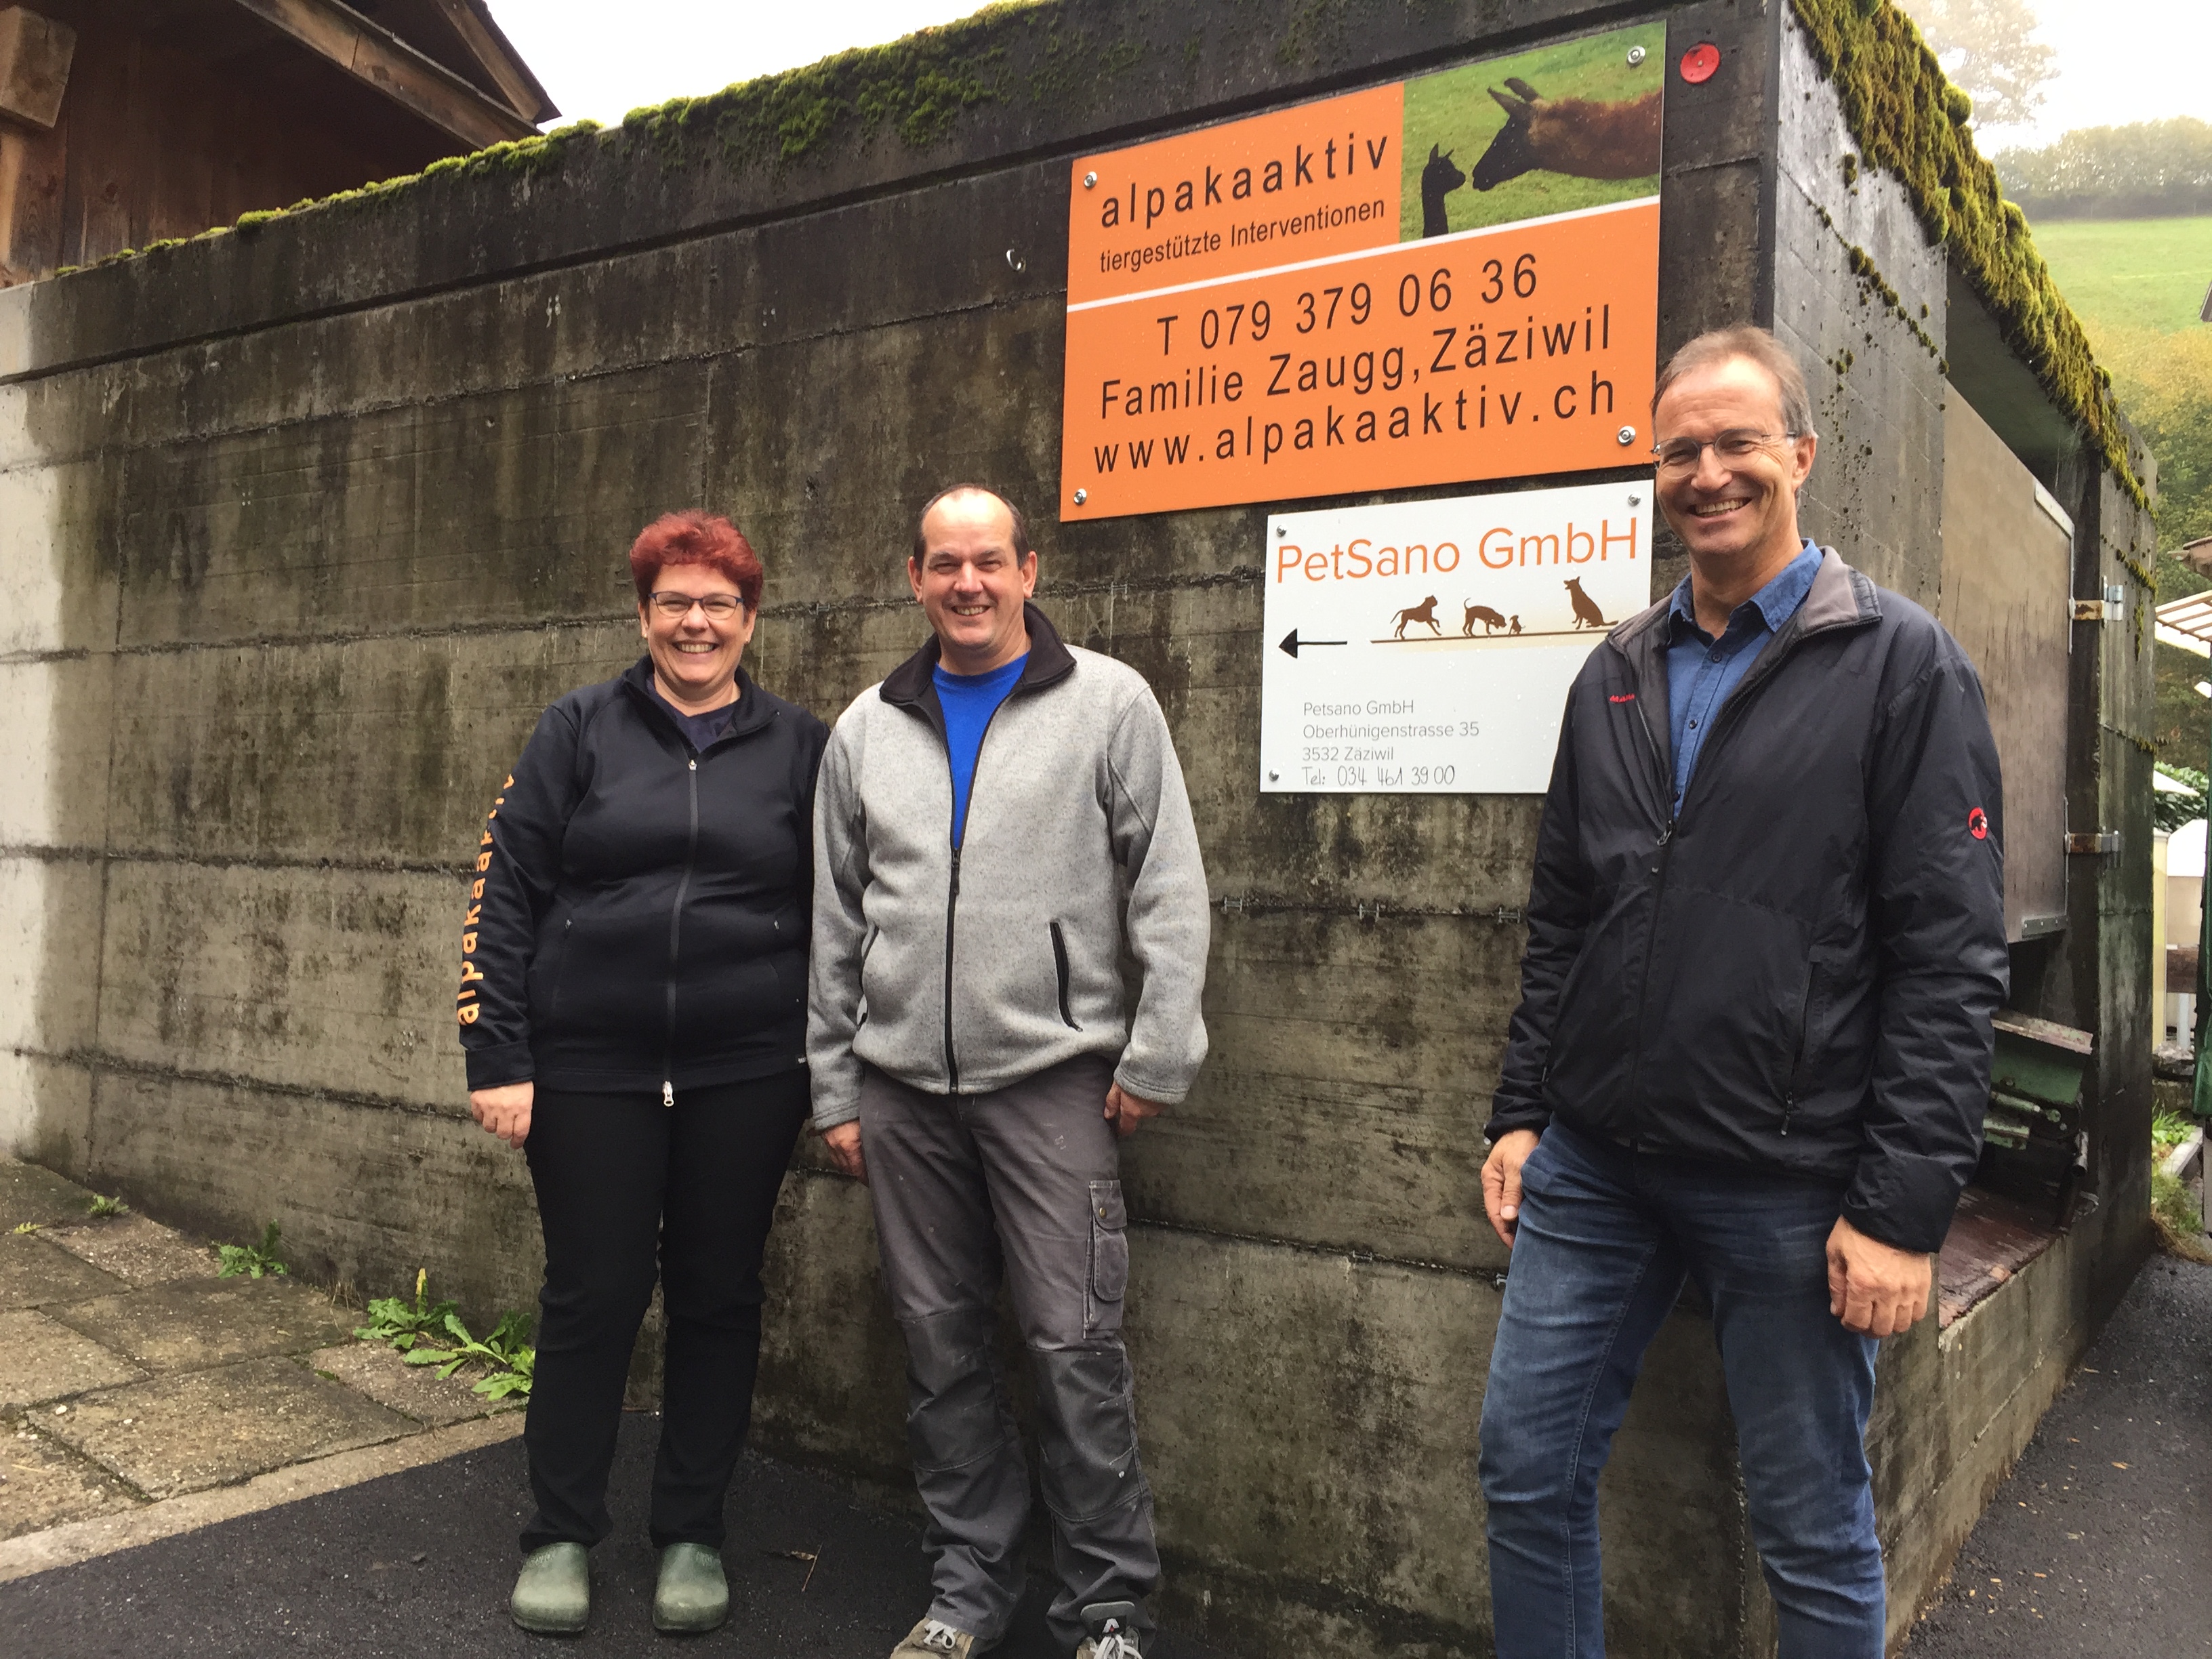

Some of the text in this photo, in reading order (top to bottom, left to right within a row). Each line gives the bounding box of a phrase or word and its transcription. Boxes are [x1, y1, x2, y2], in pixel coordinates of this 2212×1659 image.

[1101, 132, 1388, 228] alpakaaktiv
[1100, 198, 1385, 274] tiergestützte Interventionen
[1157, 253, 1537, 356] T 079 379 06 36
[1102, 364, 1243, 419] Familie
[1094, 371, 1614, 474] www.alpakaaktiv.ch
[1277, 517, 1637, 583] PetSano GmbH
[1303, 700, 1414, 716] Petsano GmbH
[1303, 722, 1479, 741] Oberhünigenstrasse 35
[1302, 745, 1394, 761] 3532 Zäziwil
[1337, 766, 1367, 786] 034
[1377, 766, 1403, 786] 461
